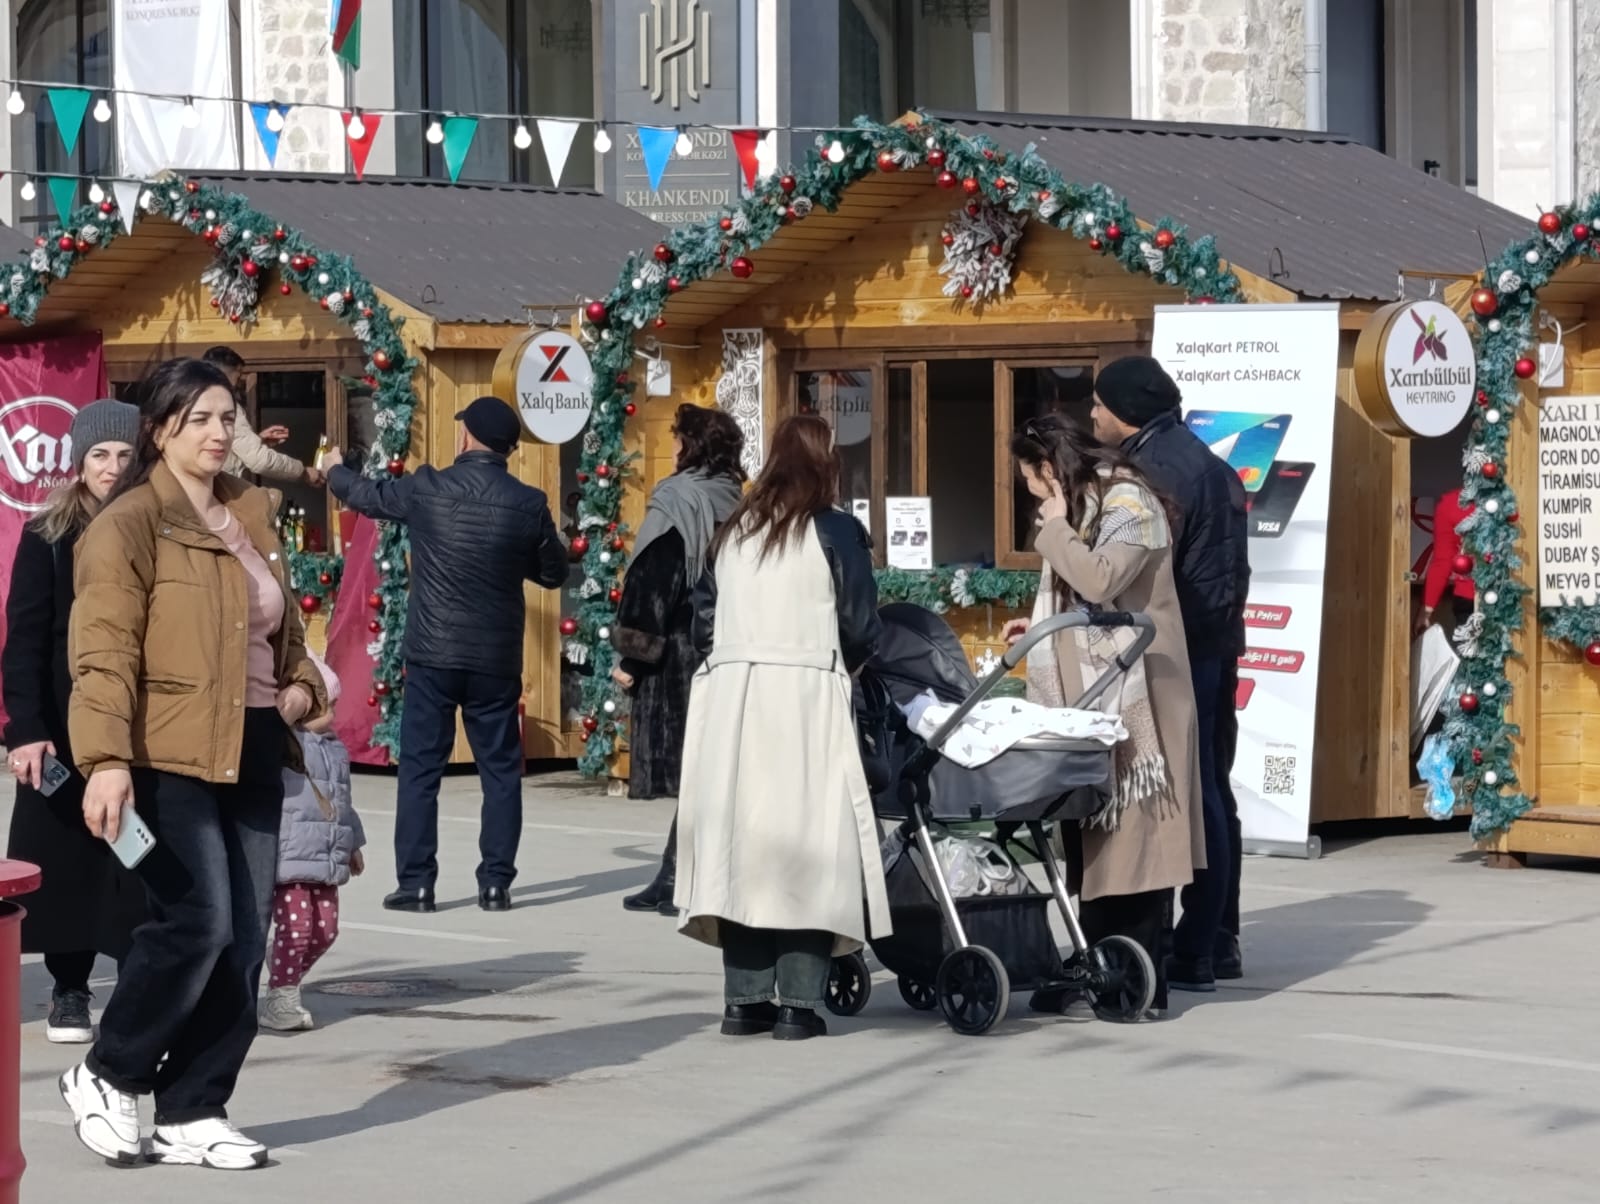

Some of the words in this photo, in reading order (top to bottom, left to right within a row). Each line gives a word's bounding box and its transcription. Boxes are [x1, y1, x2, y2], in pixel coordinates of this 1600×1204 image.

[624, 189, 730, 208] KHANKENDI
[1176, 341, 1232, 357] XalqKart
[1236, 341, 1280, 353] PETROL
[1176, 369, 1231, 385] XalqKart
[1234, 368, 1302, 382] CASHBACK
[521, 391, 590, 415] XalqBank
[1540, 404, 1588, 422] XARI
[1541, 448, 1578, 466] CORN
[1543, 493, 1593, 515] KUMPİR
[1544, 546, 1588, 564] DUBAY
[1545, 572, 1590, 590] MEYVƏ
